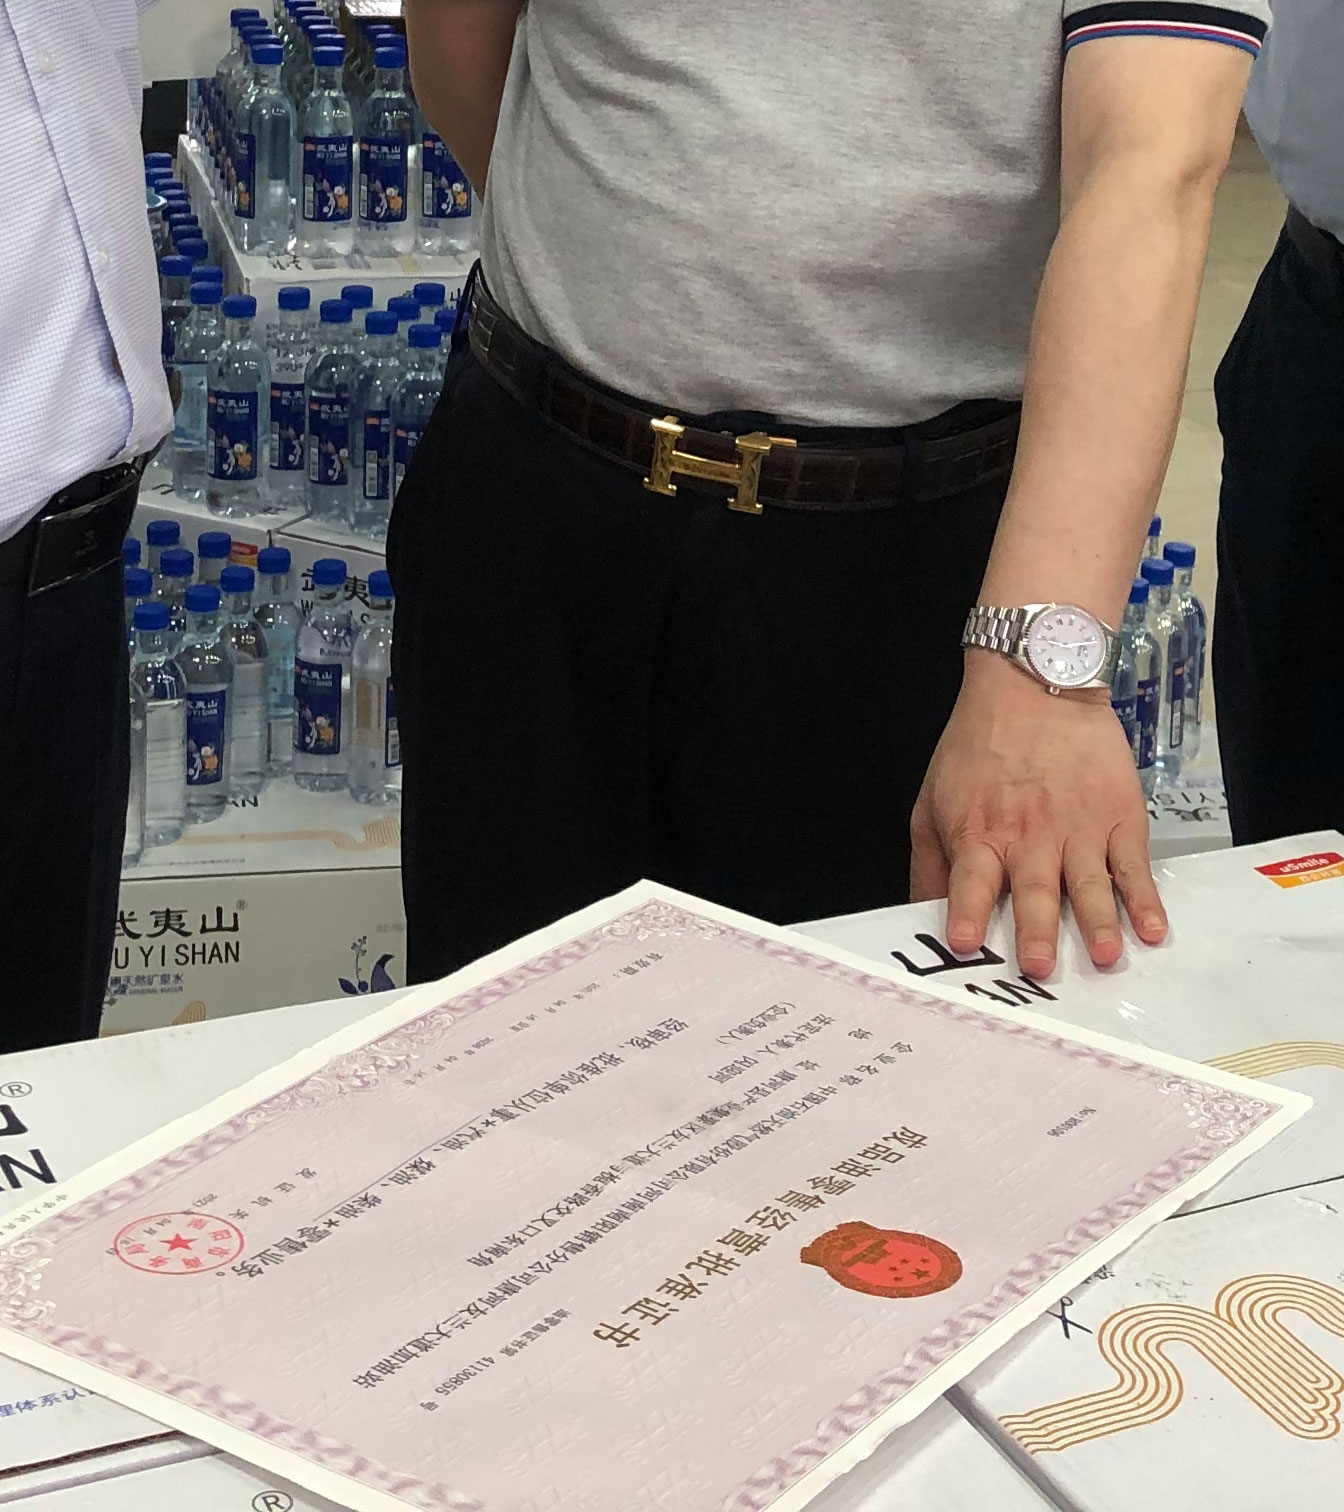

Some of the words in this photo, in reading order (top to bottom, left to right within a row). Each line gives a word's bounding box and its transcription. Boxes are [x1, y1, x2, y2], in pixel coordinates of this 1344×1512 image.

[174, 941, 241, 967] SHAN
[231, 1166, 318, 1221] 发证机关
[582, 1123, 937, 1352] 成品油零售经营批准证书
